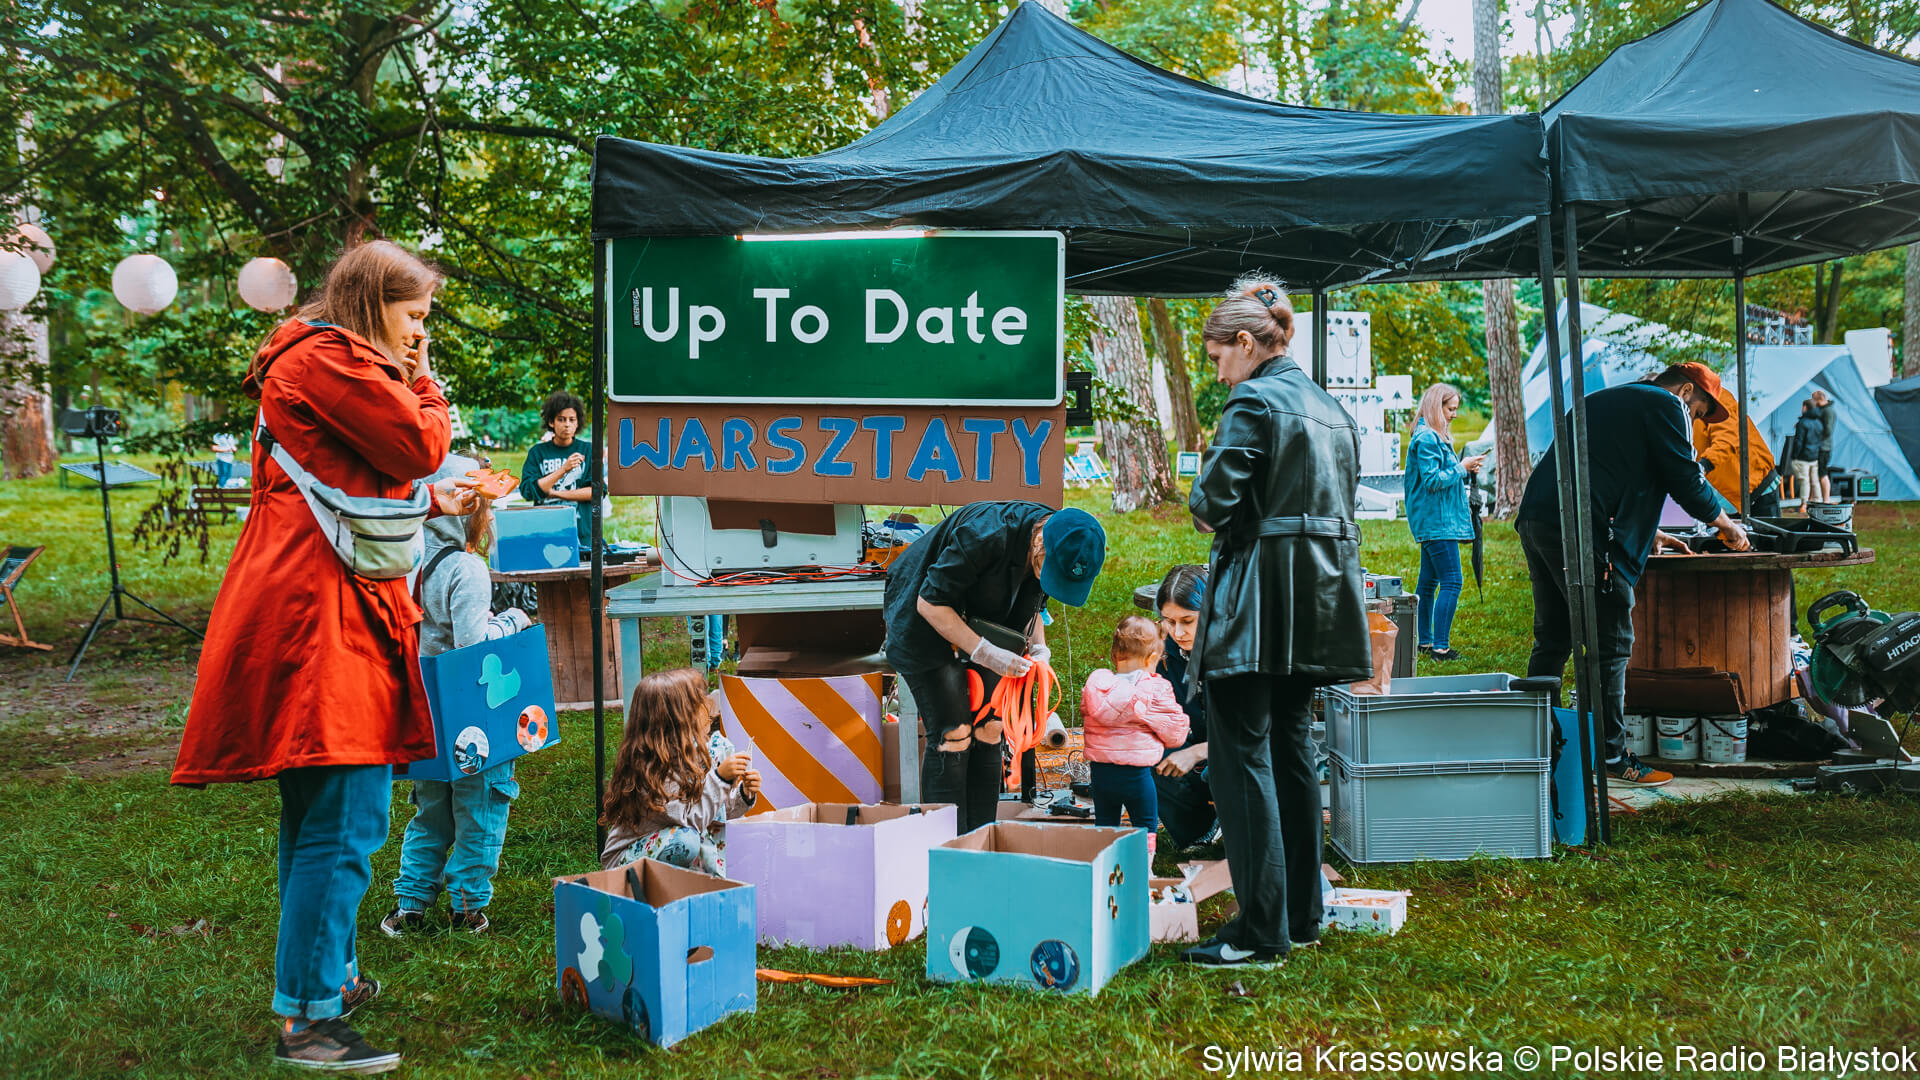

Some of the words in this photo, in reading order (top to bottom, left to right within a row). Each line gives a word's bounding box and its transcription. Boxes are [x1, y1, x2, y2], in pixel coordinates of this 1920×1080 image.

[643, 286, 727, 359] Up
[753, 288, 830, 344] To
[865, 288, 1029, 346] Date
[618, 415, 1055, 488] WARSZTATY
[1886, 633, 1920, 661] HITAC
